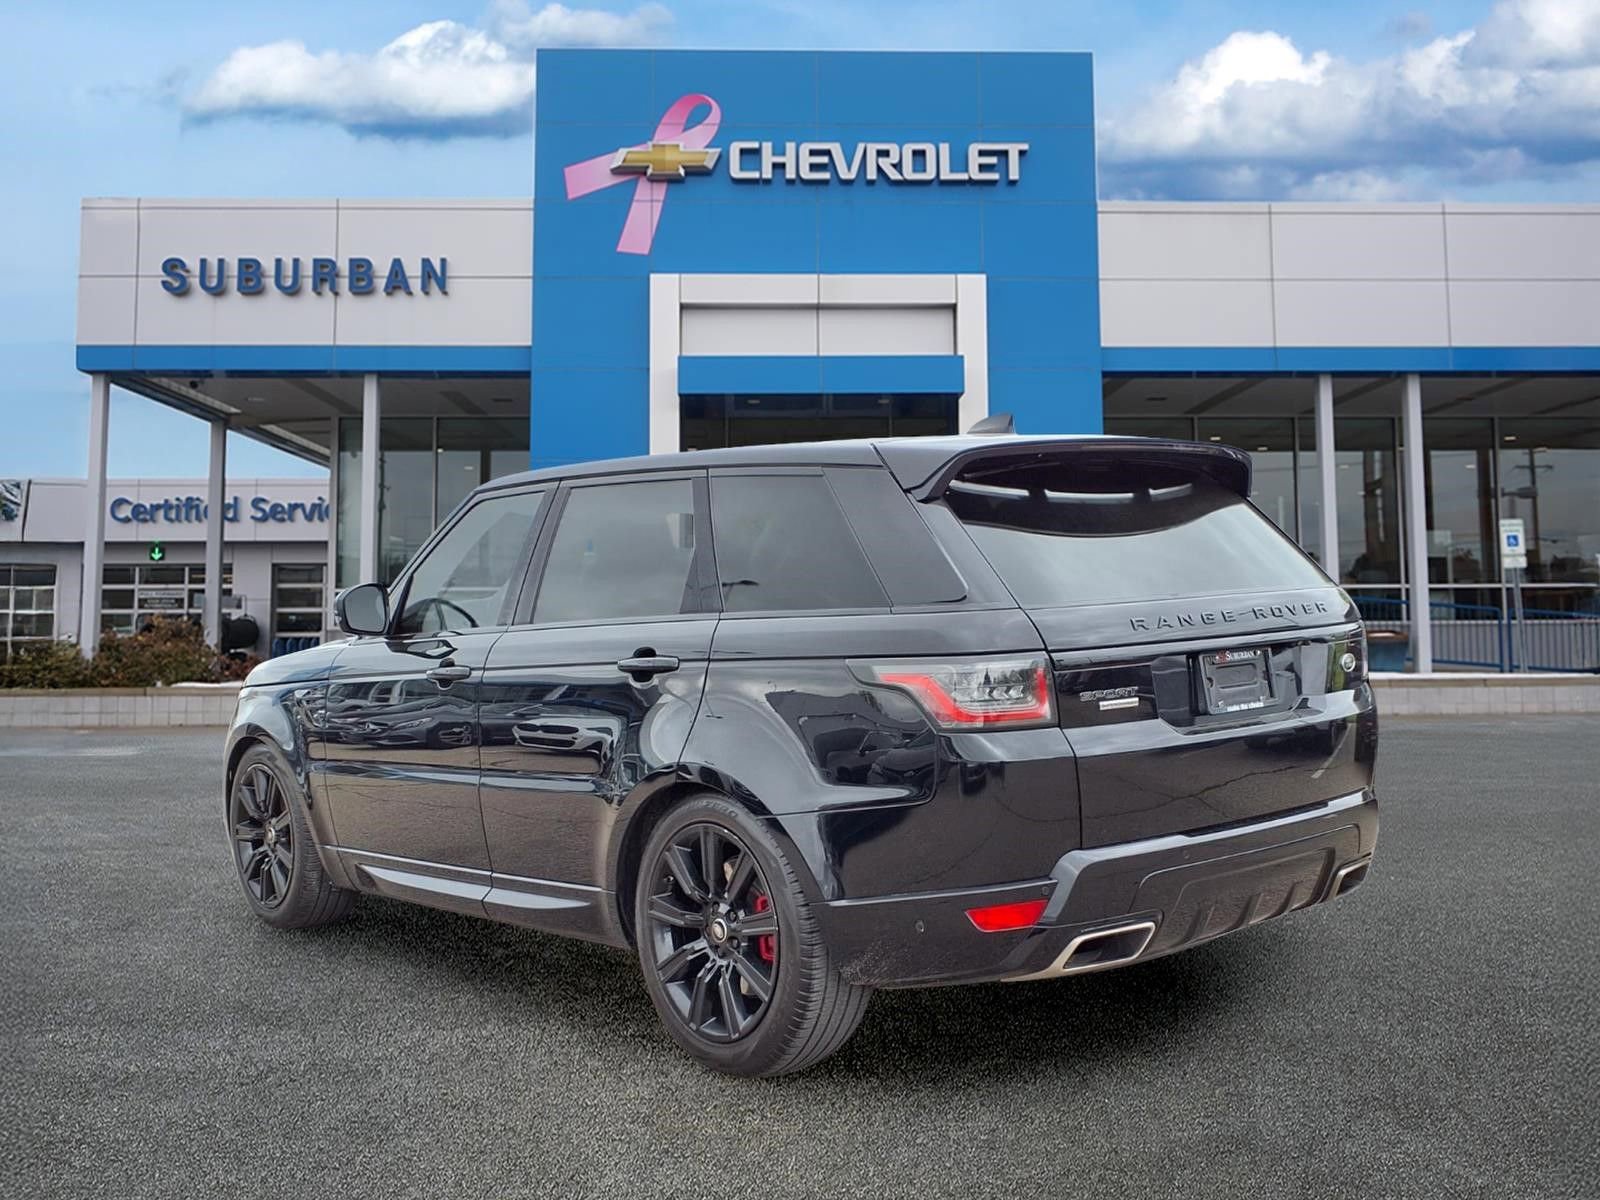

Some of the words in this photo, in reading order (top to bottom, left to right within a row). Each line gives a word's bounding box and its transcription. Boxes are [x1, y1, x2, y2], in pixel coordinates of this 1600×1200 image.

[729, 141, 1030, 183] CHEVROLET
[160, 257, 448, 296] SUBURBAN
[1130, 610, 1236, 632] RANGE
[1252, 602, 1329, 620] ROVER
[1080, 686, 1139, 701] SPORT
